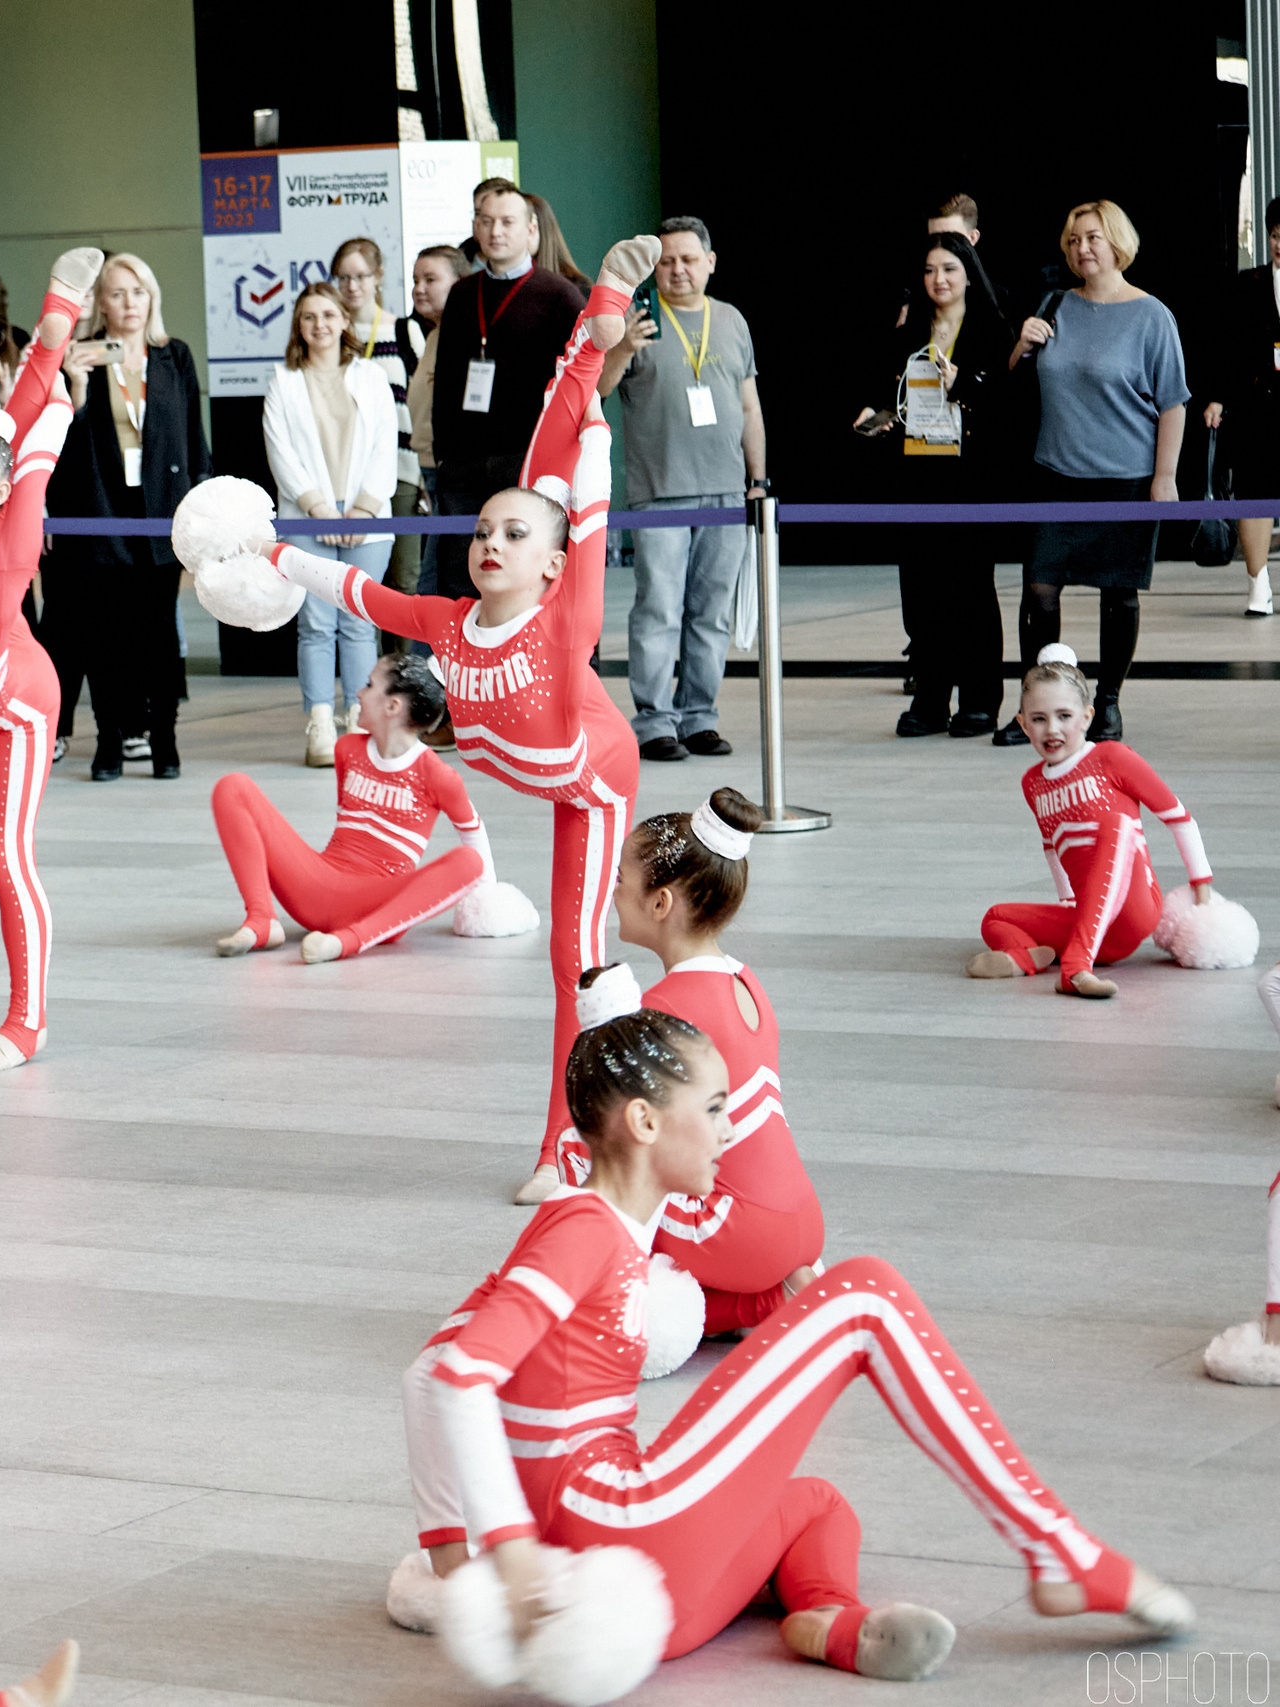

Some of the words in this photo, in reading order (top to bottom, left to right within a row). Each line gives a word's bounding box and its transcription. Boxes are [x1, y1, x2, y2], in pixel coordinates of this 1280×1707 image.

[213, 174, 272, 196] 16-17
[286, 176, 307, 192] VII
[310, 180, 389, 193] Международный
[214, 195, 272, 211] МАРТА
[344, 191, 388, 206] ТРУДА
[215, 212, 254, 227] 2023
[441, 651, 534, 702] ORIENTIR
[344, 770, 414, 811] ORIENTIR
[1035, 775, 1102, 819] ORIENTIR
